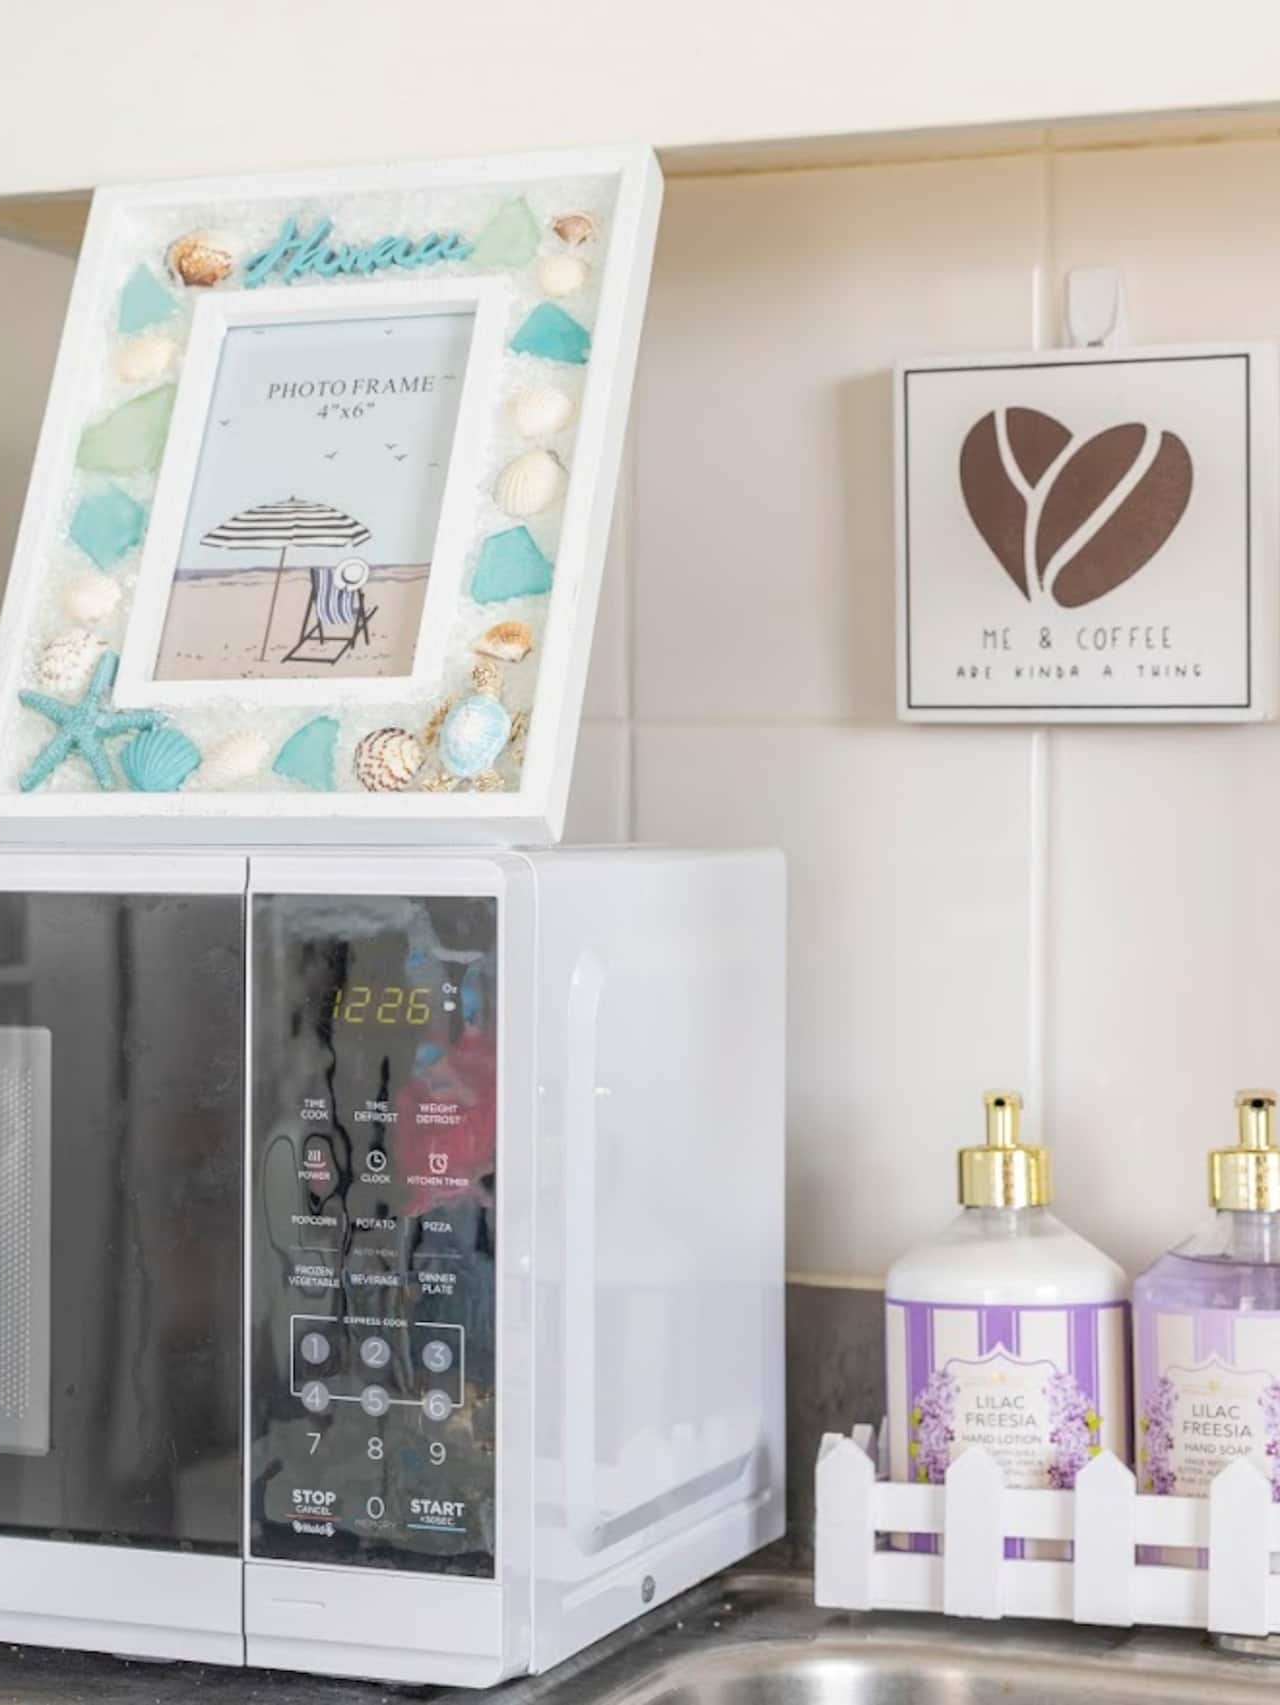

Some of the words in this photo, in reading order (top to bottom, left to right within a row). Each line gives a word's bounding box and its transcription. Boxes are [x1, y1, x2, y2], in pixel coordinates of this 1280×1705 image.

[267, 379, 347, 400] PHOTO
[352, 375, 435, 396] FRAME
[982, 627, 1011, 650] ME
[1039, 627, 1052, 649] &
[1076, 626, 1172, 650] COFFEE
[956, 665, 992, 680] ARE
[1014, 664, 1079, 680] KINDA
[1102, 665, 1113, 677] A
[1137, 664, 1203, 679] THING
[333, 987, 431, 1024] 1226
[304, 1099, 326, 1109] TIME
[365, 1102, 388, 1112] TIME
[419, 1104, 458, 1114] WEIGHT
[300, 1110, 329, 1120] COOK
[354, 1112, 399, 1123] DEFROST
[416, 1114, 461, 1125] DEFROST
[298, 1171, 330, 1181] POWER
[360, 1174, 391, 1184] CLOCK
[407, 1175, 442, 1186] KITCHEN
[445, 1177, 469, 1187] TIMER
[291, 1215, 337, 1226] POPCORN
[356, 1218, 396, 1229] POTATO
[423, 1221, 452, 1232] PIZZA
[294, 1265, 335, 1276] FROZEN
[288, 1276, 340, 1288] VEGETABLE
[350, 1274, 399, 1286] BEVERAGE
[419, 1272, 456, 1284] DINNER
[422, 1285, 454, 1296] PLATE
[310, 1338, 319, 1359] 1
[369, 1342, 384, 1363] 2
[430, 1345, 445, 1368] 3
[308, 1387, 322, 1408] 4
[369, 1390, 383, 1412] 5
[976, 1395, 1025, 1410] LILAC
[430, 1395, 445, 1417] 6
[1192, 1403, 1240, 1420] LILAC
[965, 1412, 1037, 1427] FREESIA
[1182, 1420, 1252, 1438] FREESIA
[306, 1433, 321, 1455] 7
[962, 1434, 994, 1444] HAND
[998, 1434, 1042, 1445] LOTION
[367, 1436, 384, 1460] 8
[429, 1442, 446, 1465] 9
[1184, 1443, 1217, 1454] HAND
[1219, 1445, 1253, 1456] SOAP
[292, 1489, 336, 1506] STOP
[295, 1505, 332, 1516] CANCEL
[366, 1496, 385, 1519] 0
[410, 1498, 465, 1516] START
